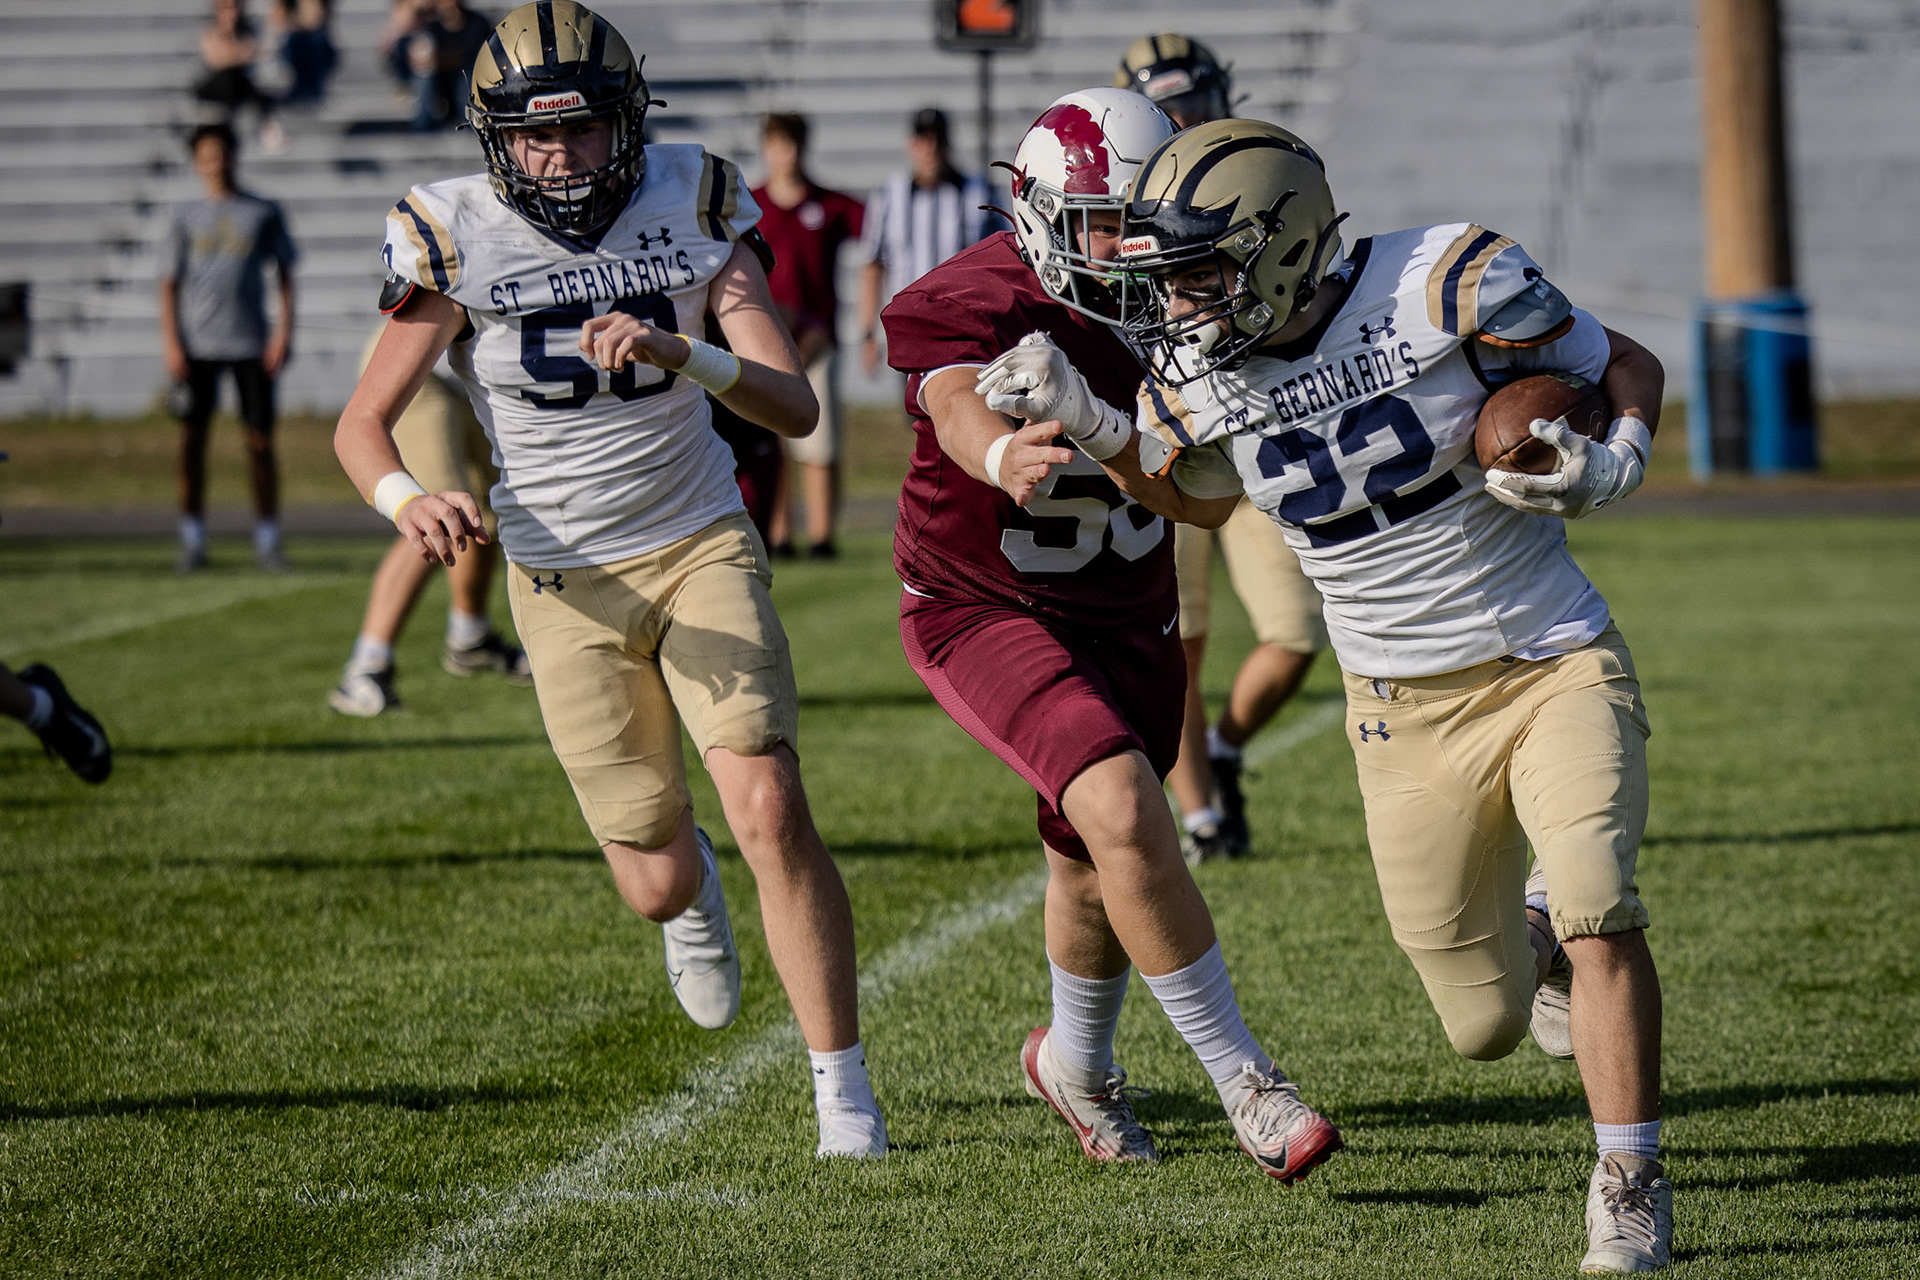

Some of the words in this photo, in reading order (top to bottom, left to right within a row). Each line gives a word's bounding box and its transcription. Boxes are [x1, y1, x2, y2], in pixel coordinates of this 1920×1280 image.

[533, 95, 579, 110] Riddell
[1122, 240, 1151, 253] Riddell
[547, 250, 695, 306] BERNARD'S
[1268, 341, 1420, 424] BERNARD'S
[1256, 393, 1463, 549] 22
